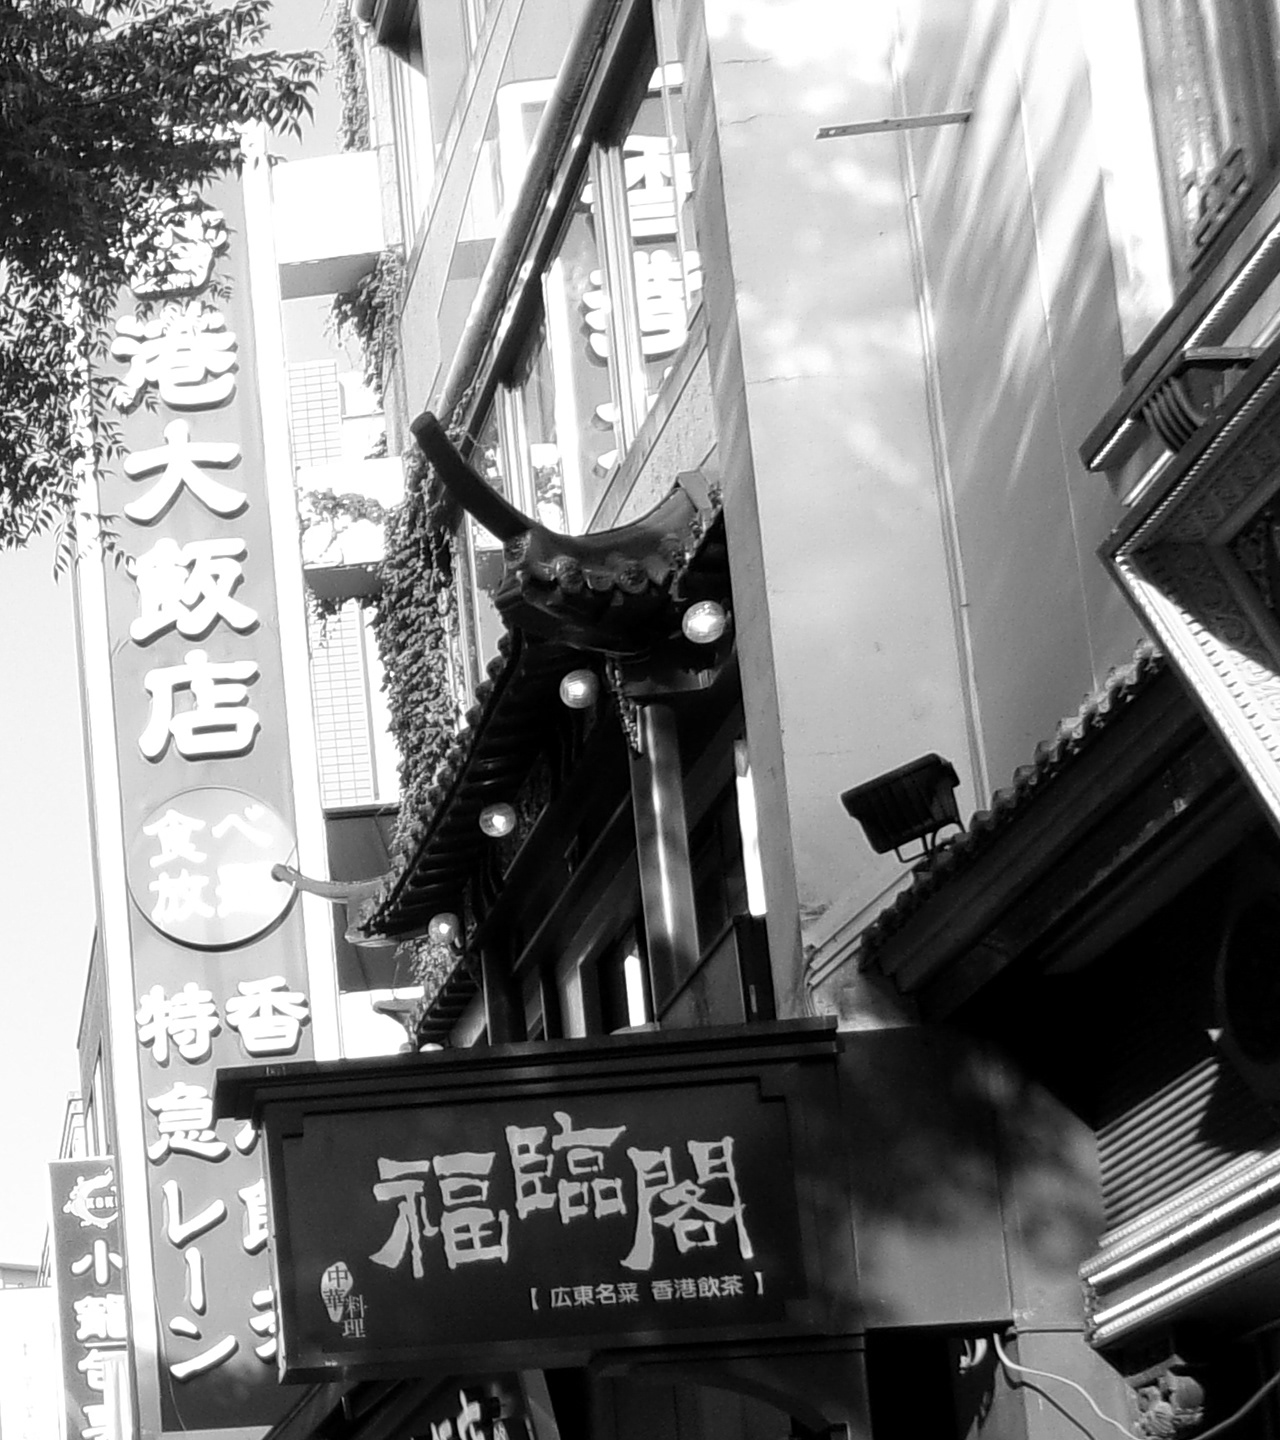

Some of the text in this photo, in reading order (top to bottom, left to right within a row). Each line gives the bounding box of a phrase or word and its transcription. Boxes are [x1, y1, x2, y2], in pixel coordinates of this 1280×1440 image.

[137, 983, 238, 1380] 特急レーン
[369, 1111, 754, 1279] 福臨閣
